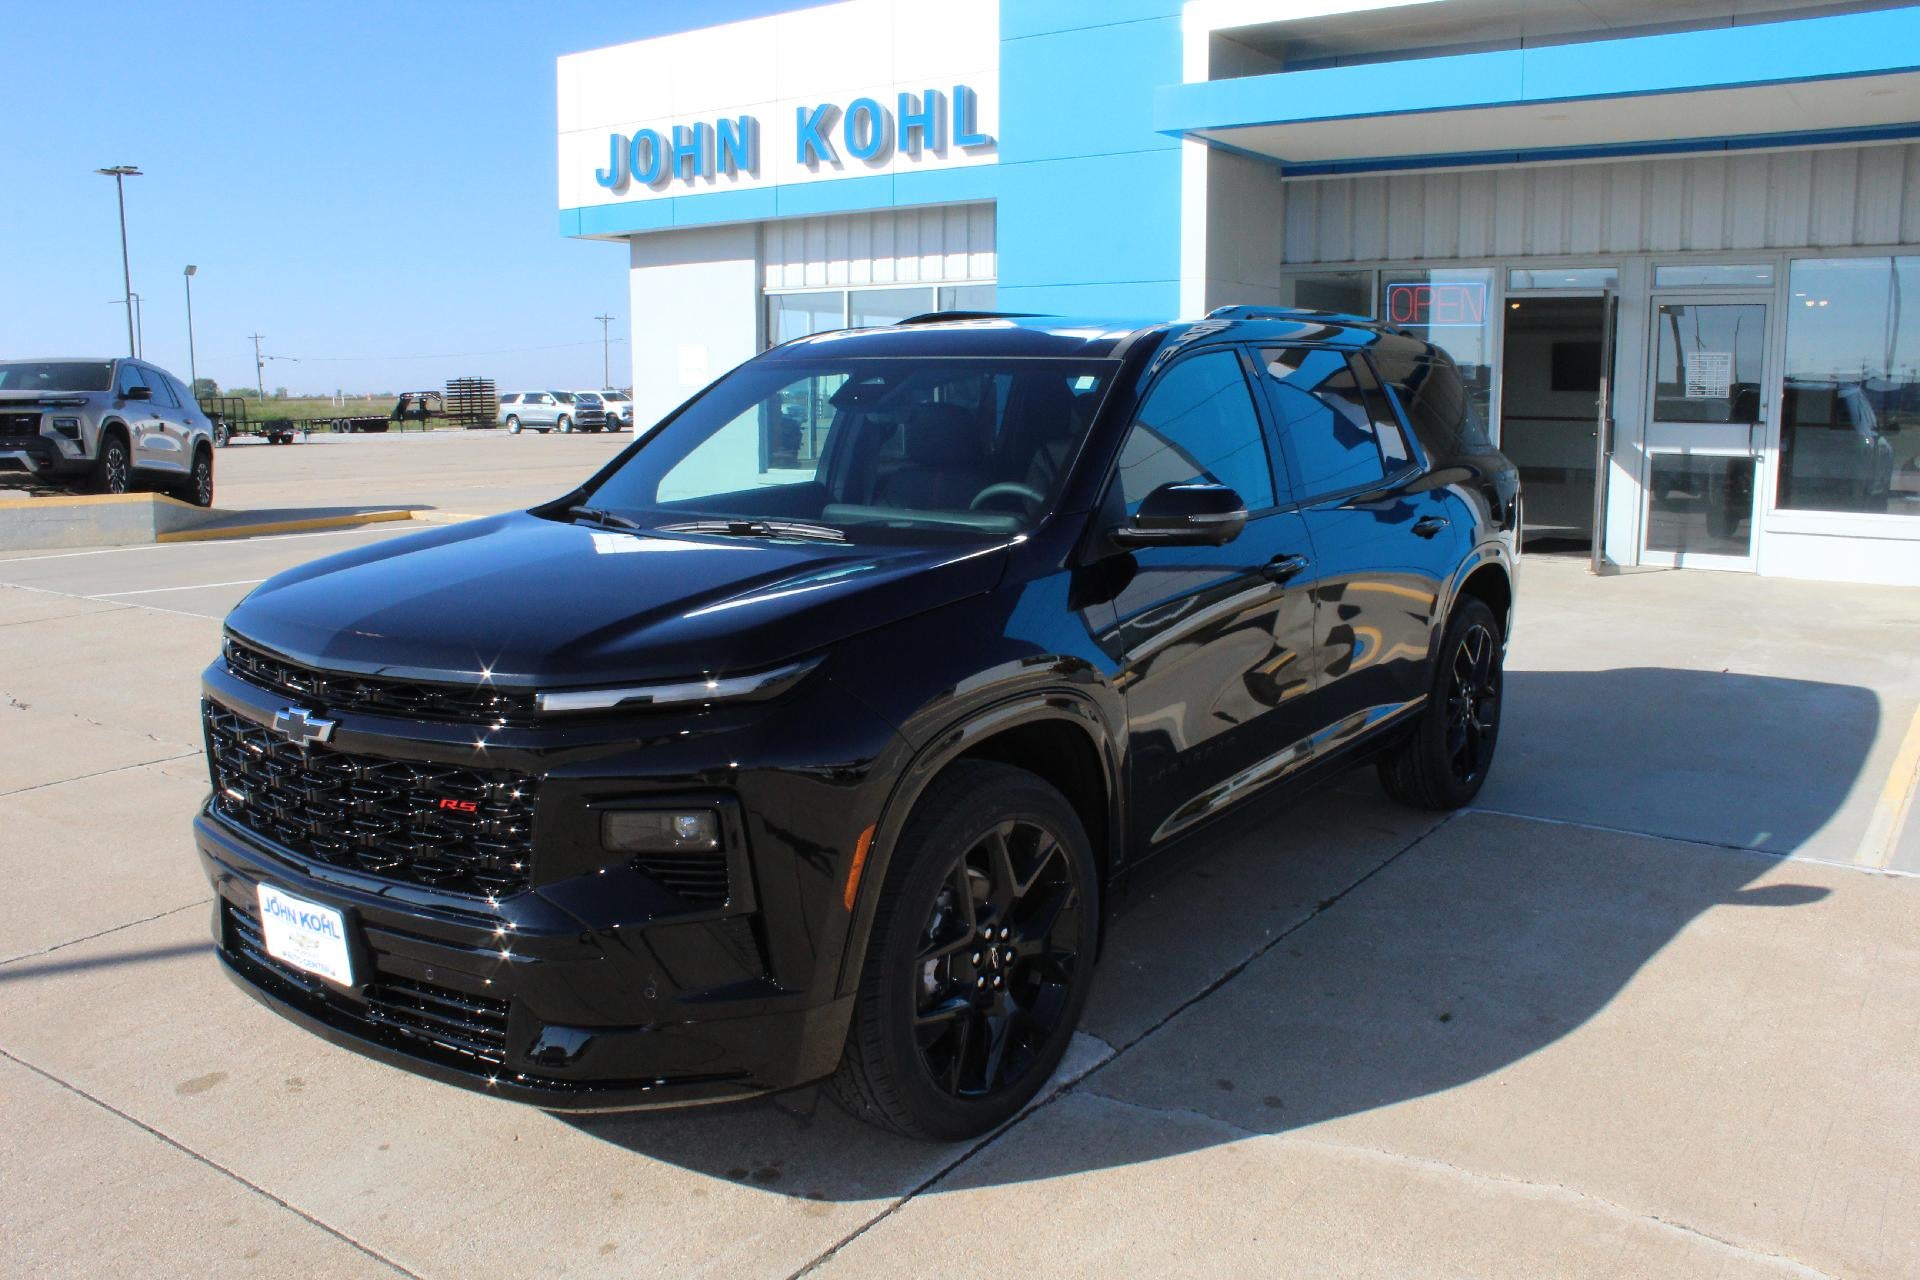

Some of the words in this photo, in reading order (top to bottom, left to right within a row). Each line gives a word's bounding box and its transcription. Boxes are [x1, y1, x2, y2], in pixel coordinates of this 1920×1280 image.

[596, 115, 757, 189] JOHN
[797, 85, 994, 163] KOHL
[1391, 287, 1484, 322] OPEN
[440, 799, 476, 812] RS
[263, 897, 297, 925] JOHN
[299, 911, 341, 939] KOHL
